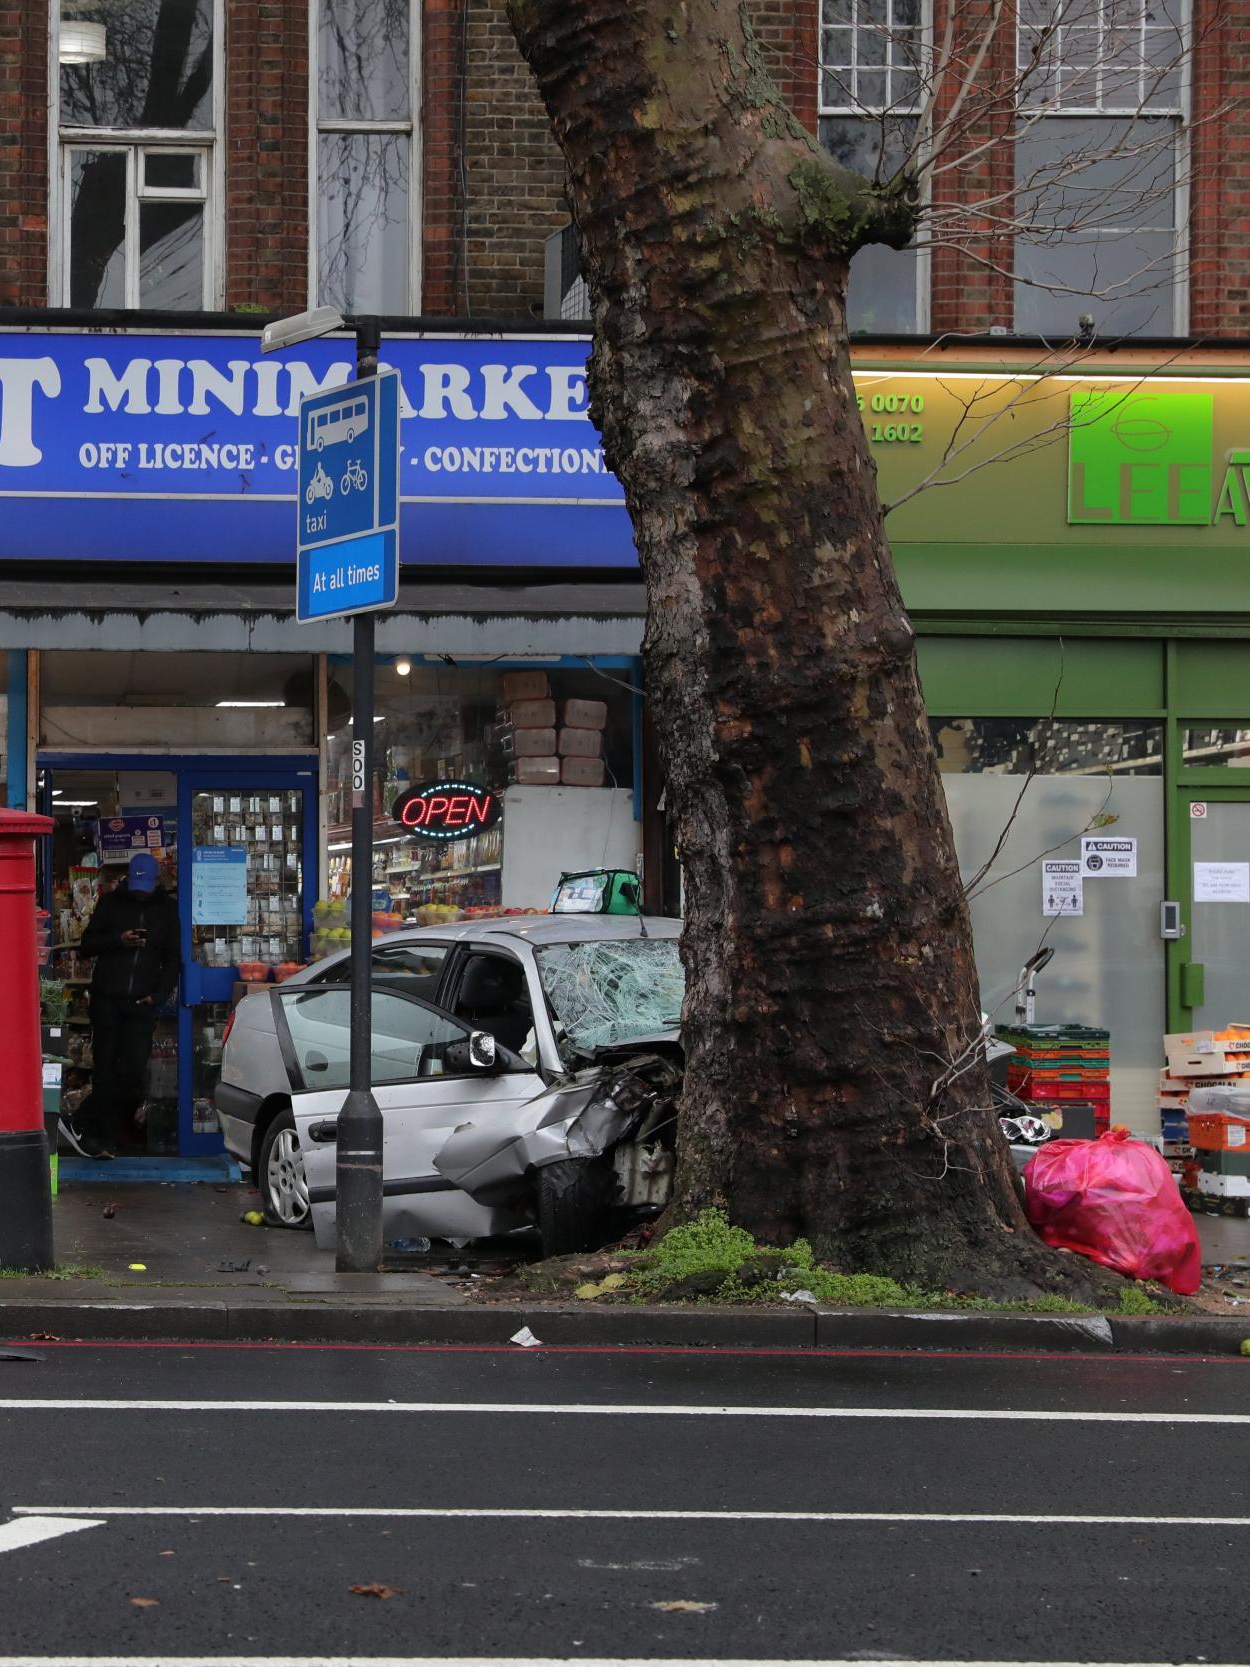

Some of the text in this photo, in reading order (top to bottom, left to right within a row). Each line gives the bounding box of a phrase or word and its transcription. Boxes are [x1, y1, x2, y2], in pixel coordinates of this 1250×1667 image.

[871, 394, 924, 413] 0070
[872, 424, 923, 442] 1602
[79, 442, 132, 469] OFF
[137, 443, 255, 470] LICENCE
[305, 509, 327, 533] taxi
[313, 564, 380, 593] At all times
[401, 795, 491, 827] OPEN
[1046, 864, 1078, 872] CAUTION
